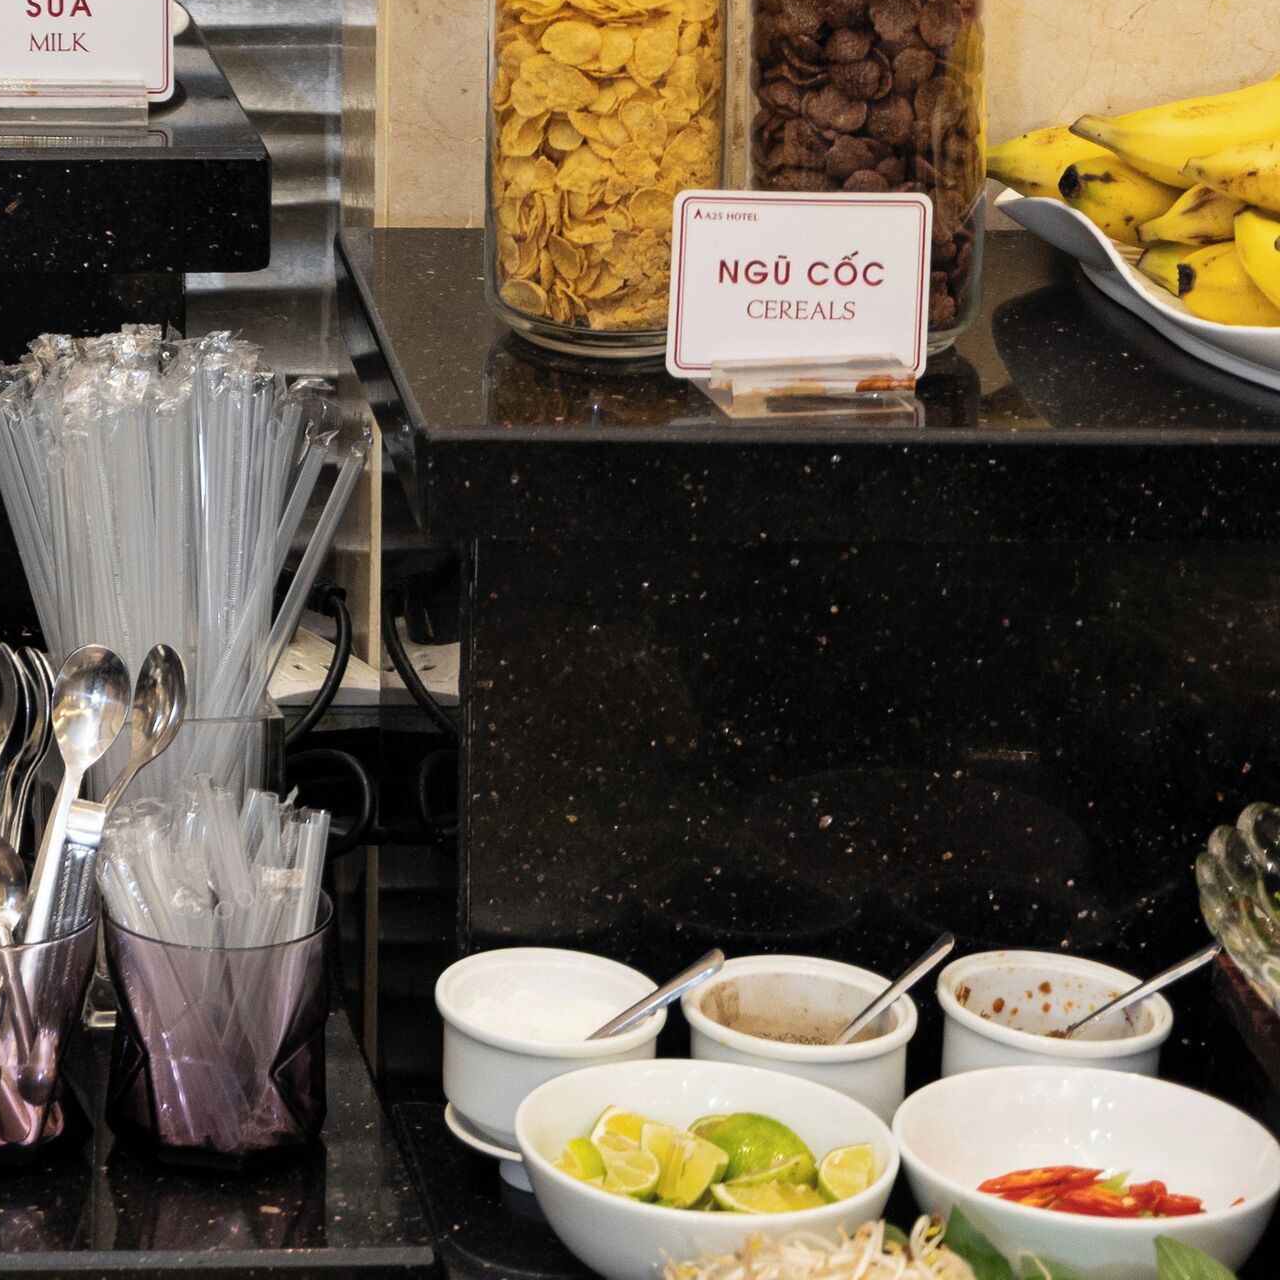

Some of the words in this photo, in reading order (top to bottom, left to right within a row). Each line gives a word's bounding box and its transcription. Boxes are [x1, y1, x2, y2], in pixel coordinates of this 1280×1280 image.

[29, 32, 90, 53] MILK
[705, 211, 723, 220] A25
[726, 212, 758, 222] HOTEL
[718, 255, 791, 286] NGŨ
[807, 251, 885, 287] CỐC
[746, 299, 856, 321] CEREALS
